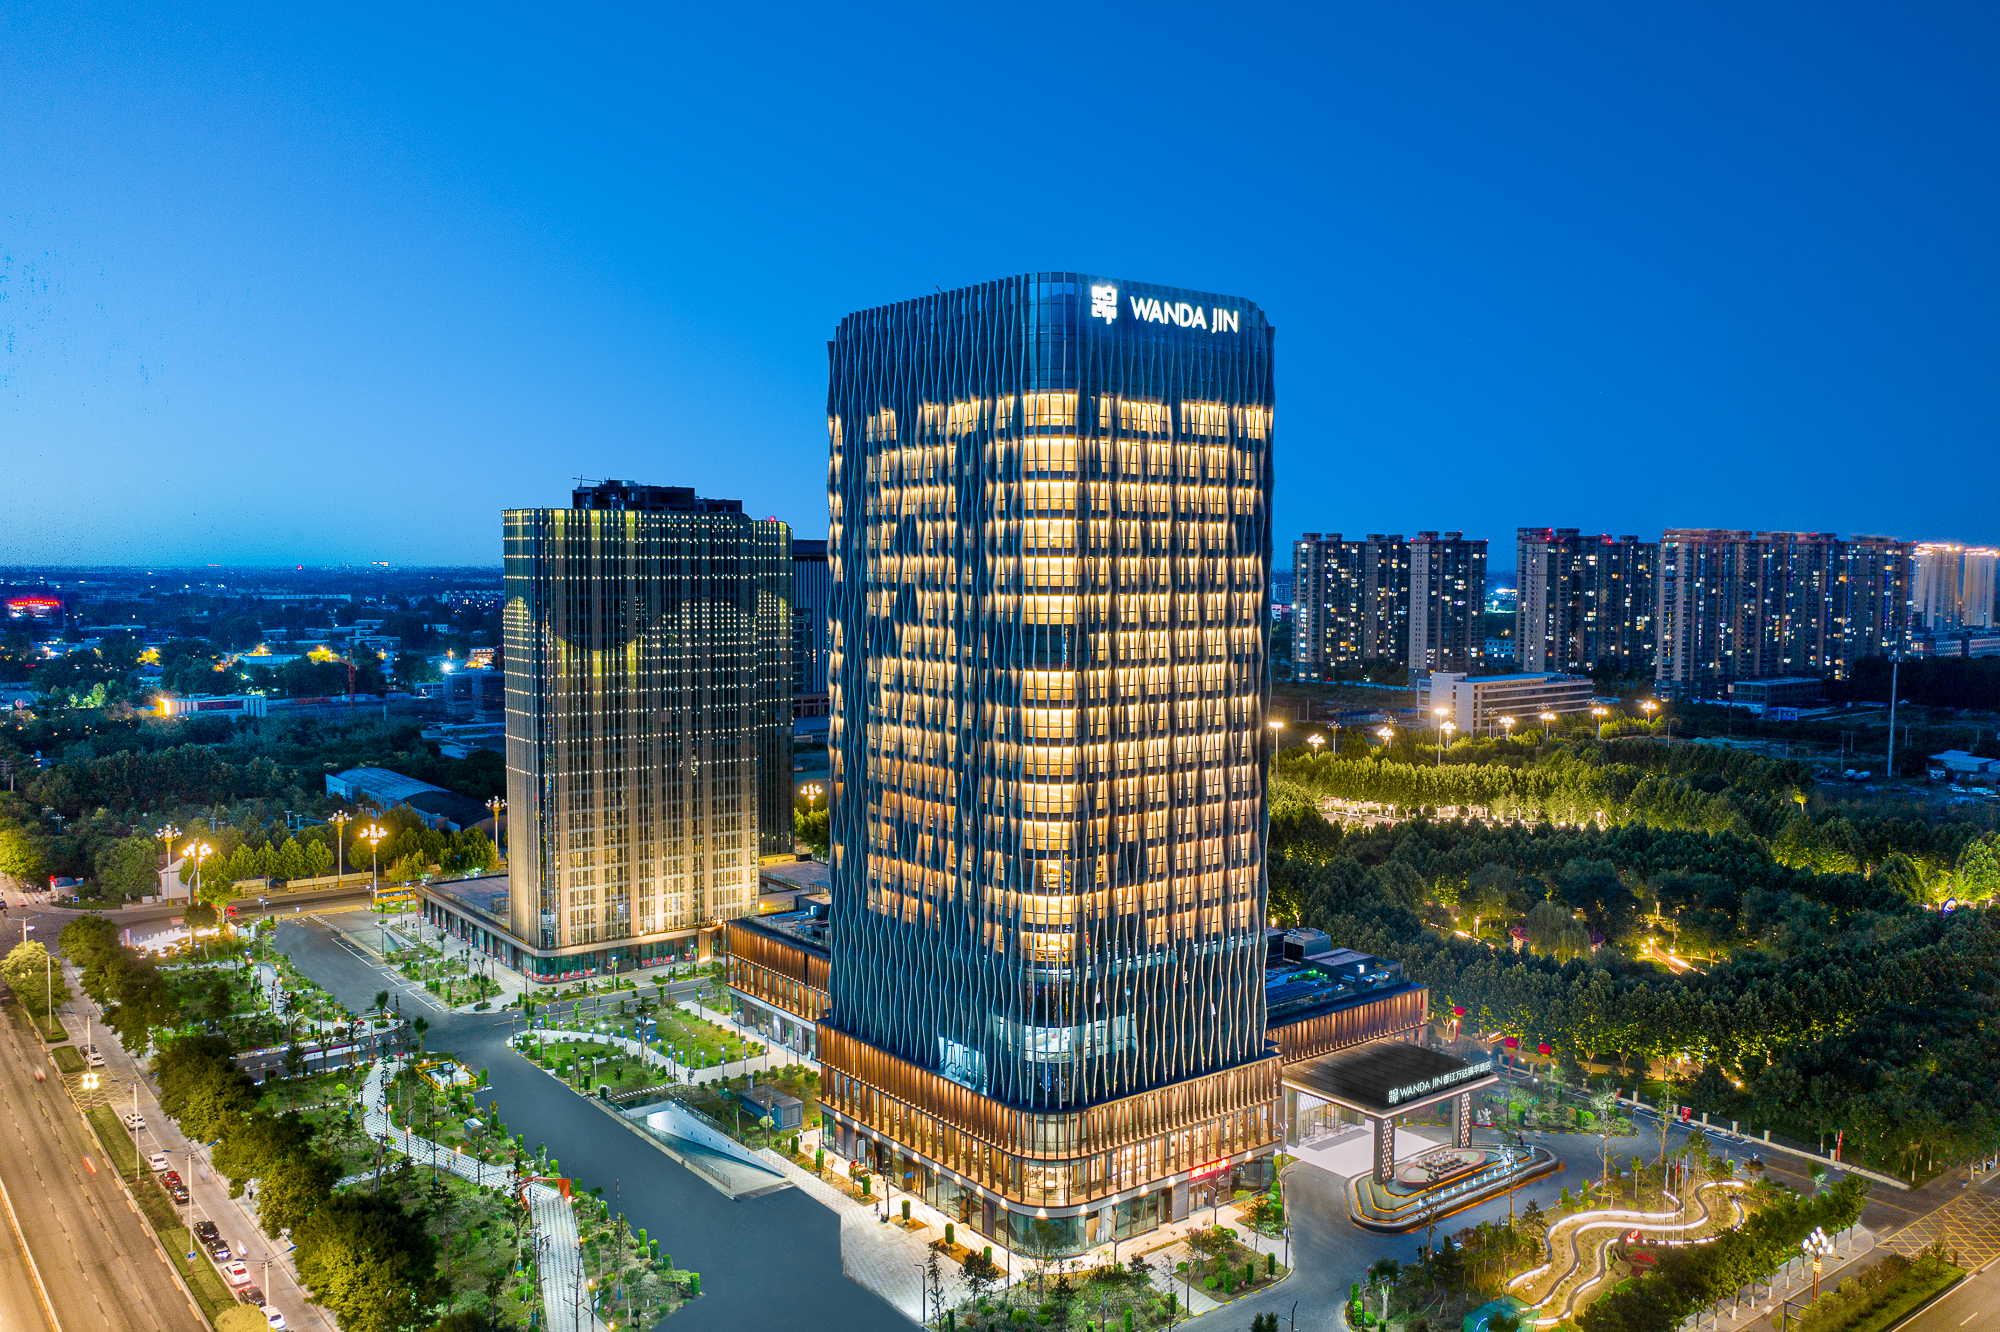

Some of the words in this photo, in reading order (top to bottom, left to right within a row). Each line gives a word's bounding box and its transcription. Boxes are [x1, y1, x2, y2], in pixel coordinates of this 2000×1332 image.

[1130, 295, 1207, 330] WANDA
[1211, 307, 1239, 334] JIN
[1399, 1080, 1431, 1098] WANDA
[1432, 1075, 1443, 1089] JIN
